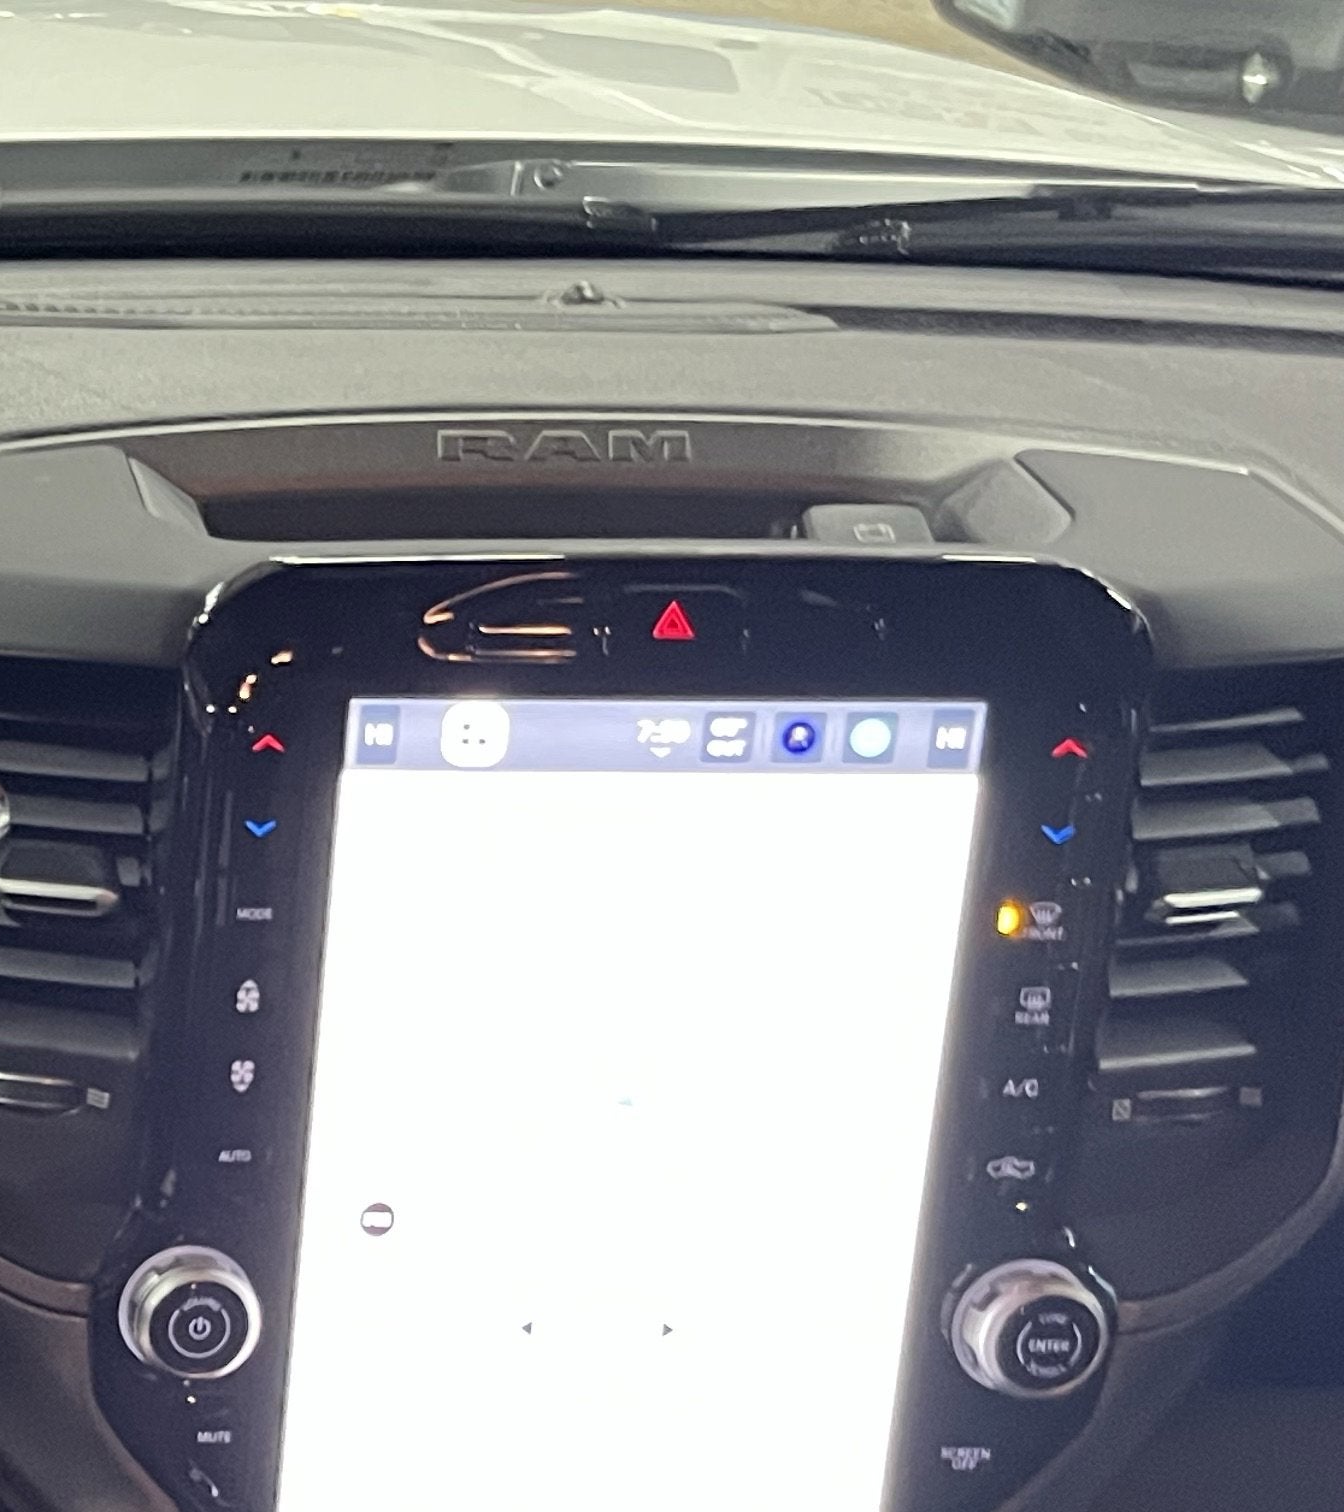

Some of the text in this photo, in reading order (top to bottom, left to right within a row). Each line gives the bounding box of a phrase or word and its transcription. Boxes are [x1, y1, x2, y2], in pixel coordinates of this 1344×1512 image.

[438, 430, 691, 462] RAM
[1003, 1079, 1039, 1098] A/C
[218, 1150, 252, 1163] AUTO
[1028, 1338, 1070, 1354] ENTER
[197, 1430, 232, 1444] MUTE
[940, 1447, 991, 1460] SCREEN
